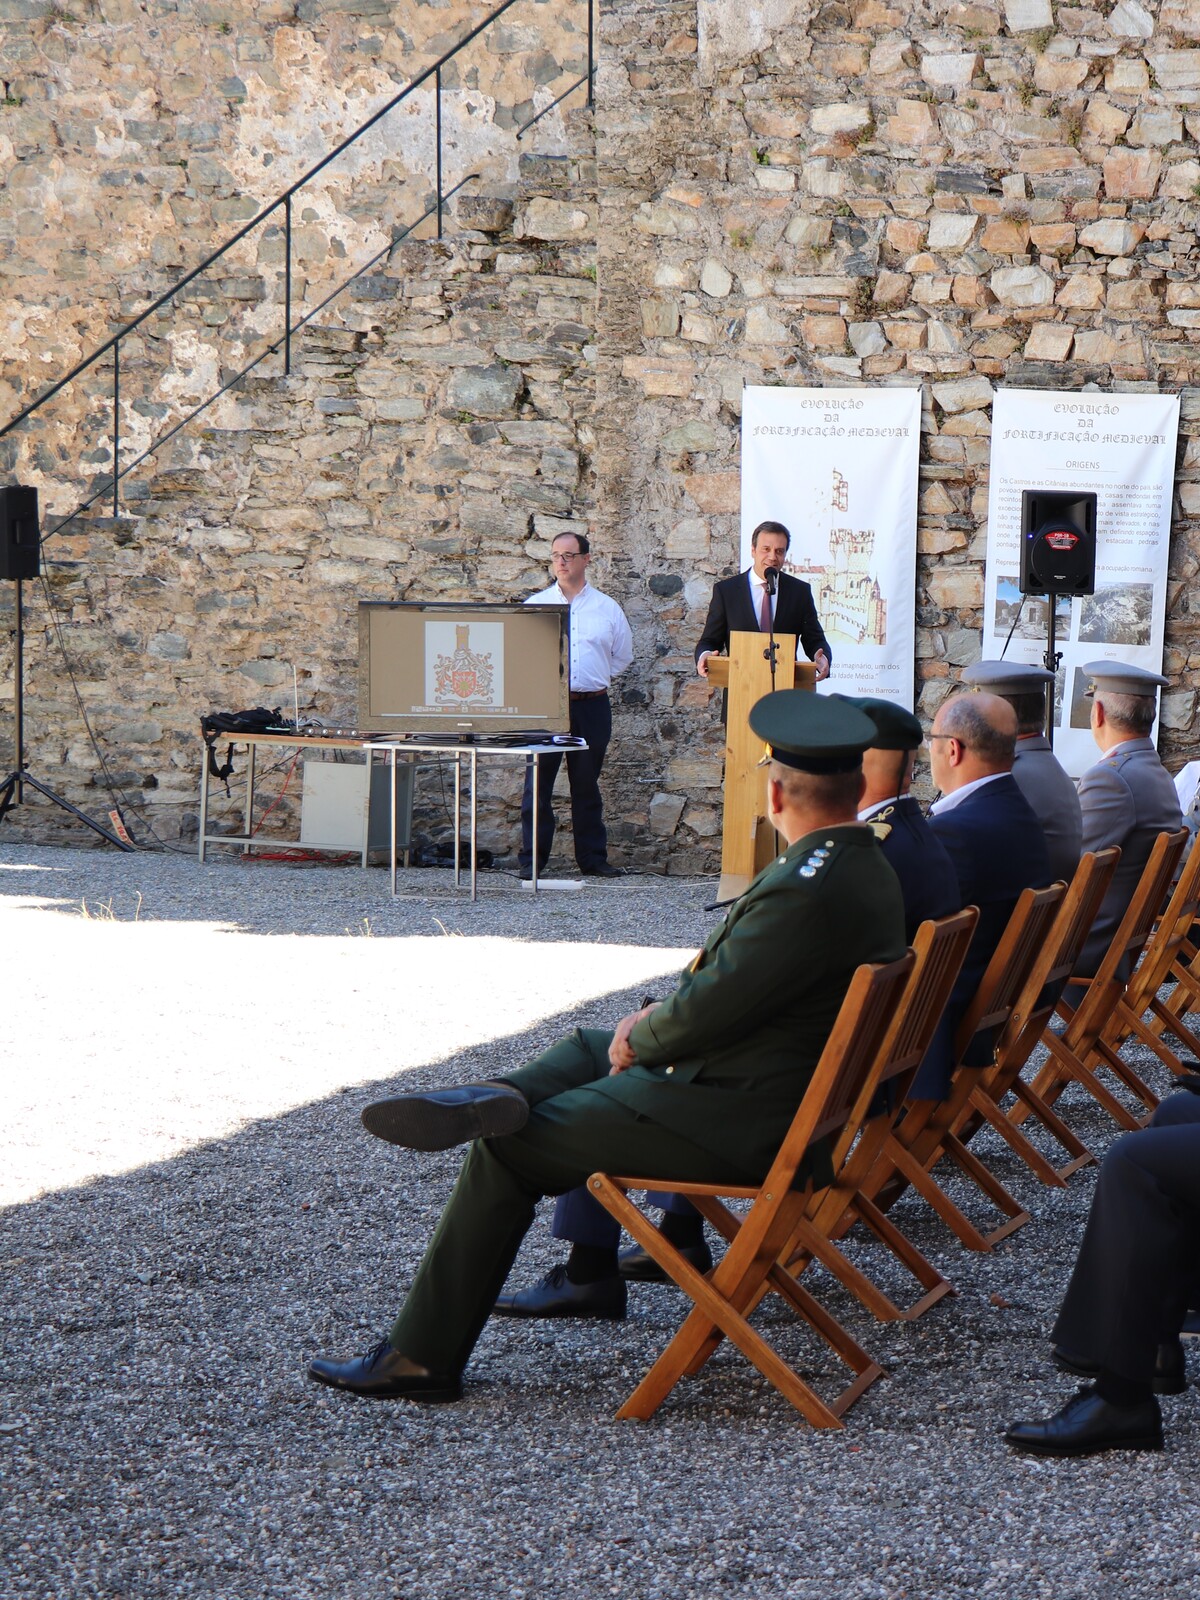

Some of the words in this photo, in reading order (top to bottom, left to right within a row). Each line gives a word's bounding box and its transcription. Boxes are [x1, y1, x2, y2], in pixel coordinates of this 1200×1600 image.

[801, 399, 864, 409] EVOLUÇÃO
[1054, 403, 1119, 416] EVOLUÇÃO
[824, 414, 840, 423] DA
[1078, 419, 1094, 428] DA
[1066, 461, 1100, 469] ORIGENS
